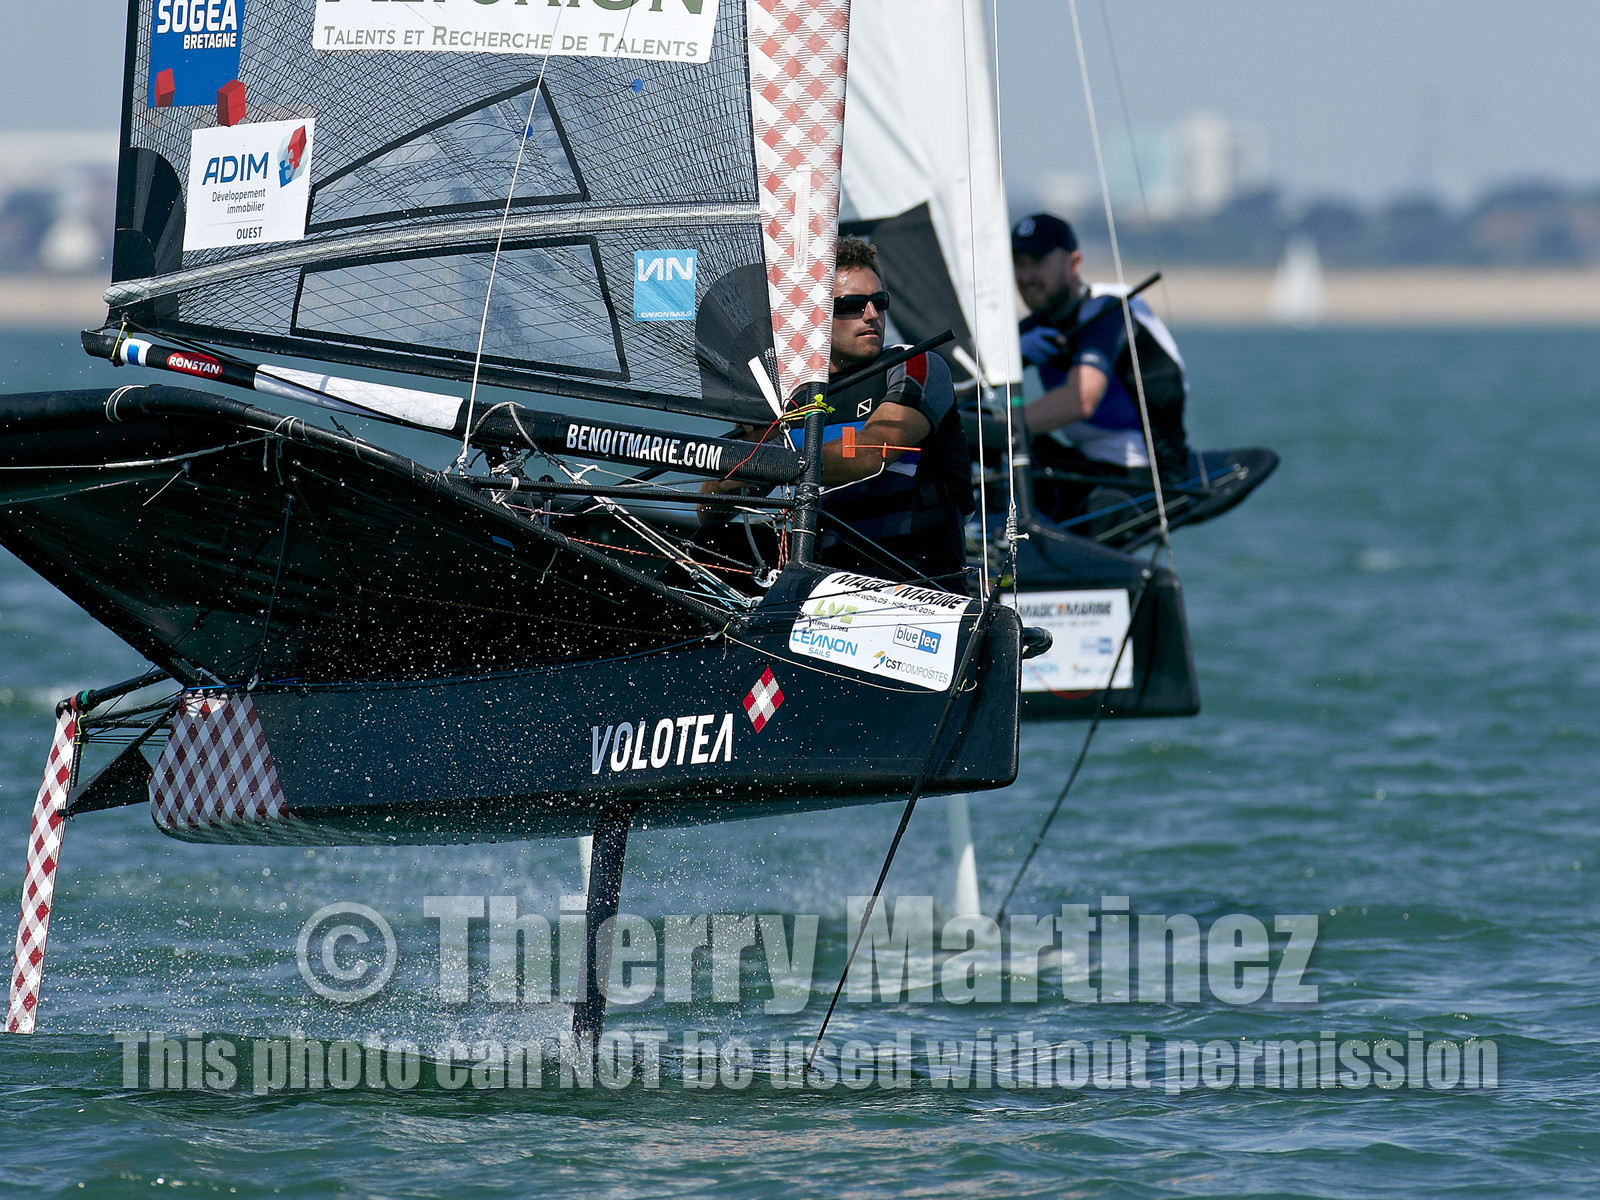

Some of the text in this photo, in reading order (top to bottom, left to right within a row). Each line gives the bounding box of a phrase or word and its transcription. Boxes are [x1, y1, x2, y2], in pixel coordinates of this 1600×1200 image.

[183, 32, 237, 50] BRETAGNE
[201, 152, 269, 186] ADIM
[212, 188, 266, 203] Développement
[227, 201, 265, 214] immobilier
[236, 226, 263, 240] OUEST
[168, 356, 221, 375] RONSTAN
[566, 423, 723, 471] BENOITMARIE.COM
[894, 586, 968, 610] MARINE
[919, 607, 936, 615] 2014
[808, 646, 831, 659] SAILS
[591, 712, 734, 775] VOLOTEA
